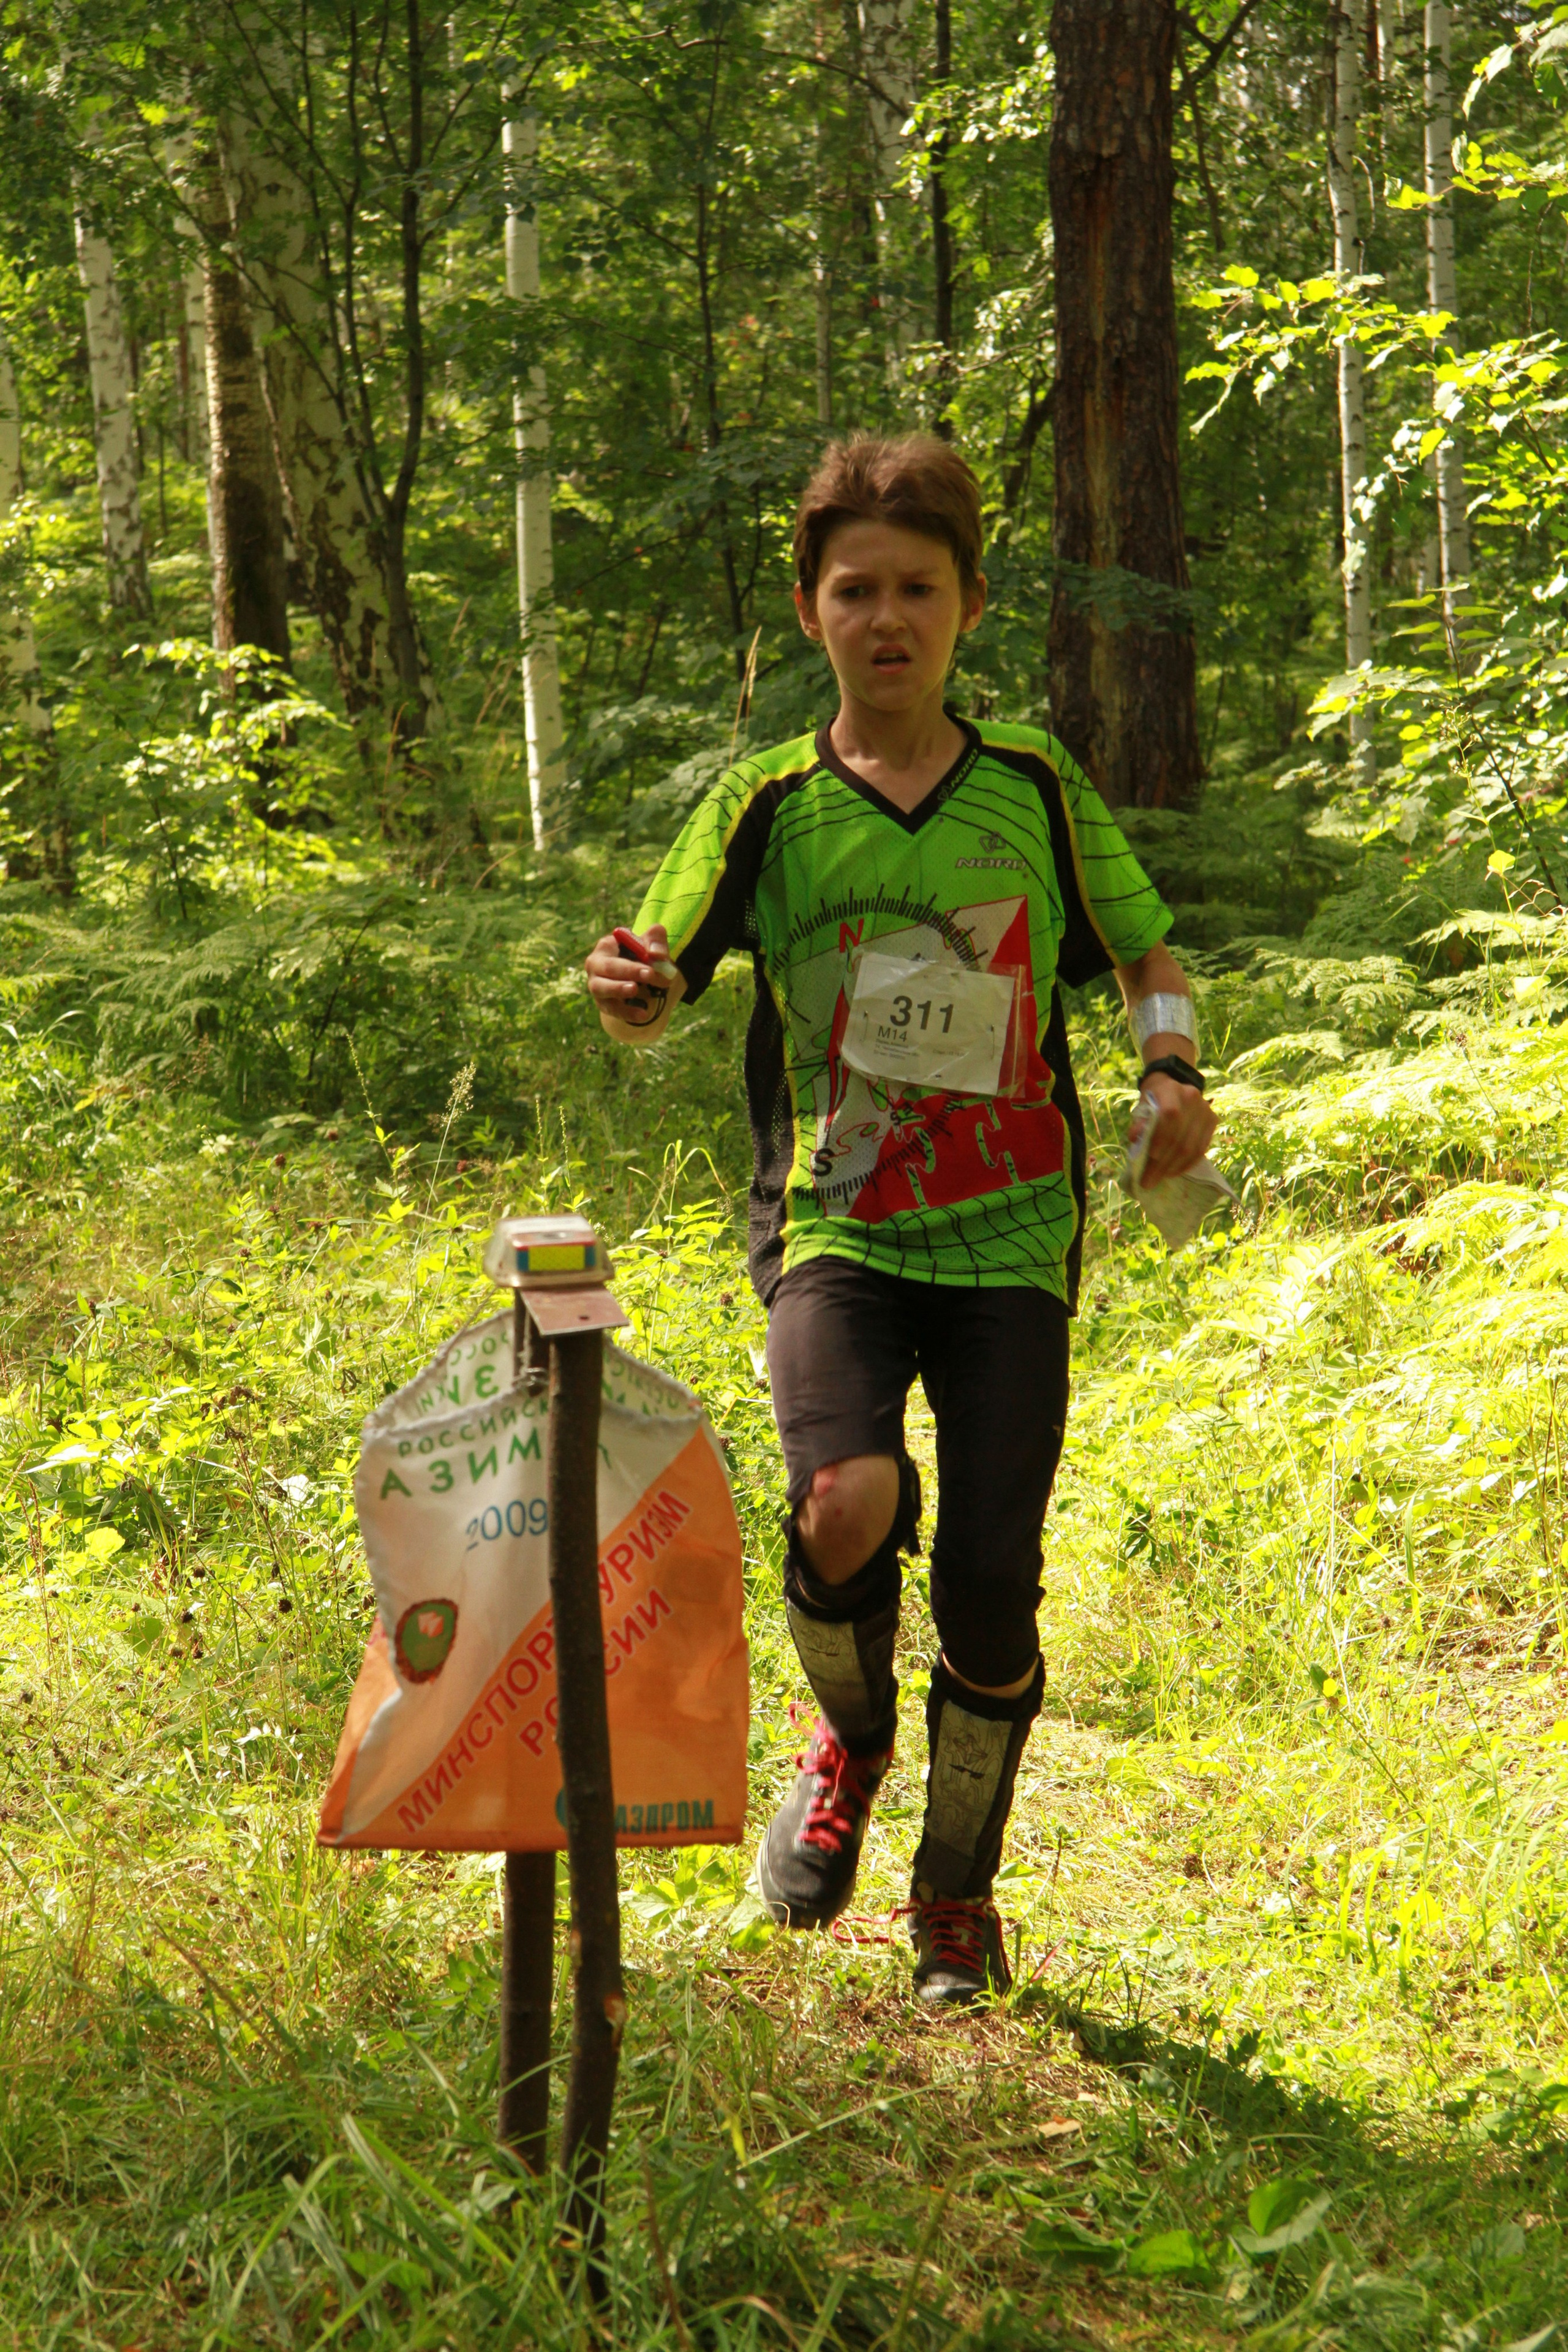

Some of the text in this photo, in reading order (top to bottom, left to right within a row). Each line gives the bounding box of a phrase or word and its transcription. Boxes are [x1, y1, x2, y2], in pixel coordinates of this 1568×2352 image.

[951, 748, 978, 788] NORD
[955, 858, 1027, 870] NORD
[839, 918, 864, 954] N
[890, 995, 954, 1033] 311
[878, 1025, 908, 1042] M14
[813, 1148, 834, 1177] S
[398, 1397, 549, 1458] РОССИЙСК
[380, 1427, 611, 1500] АЗИМ
[397, 1491, 691, 1833] МИНСПОРУРИЗМ
[614, 1798, 714, 1834] АЗПРОМ
